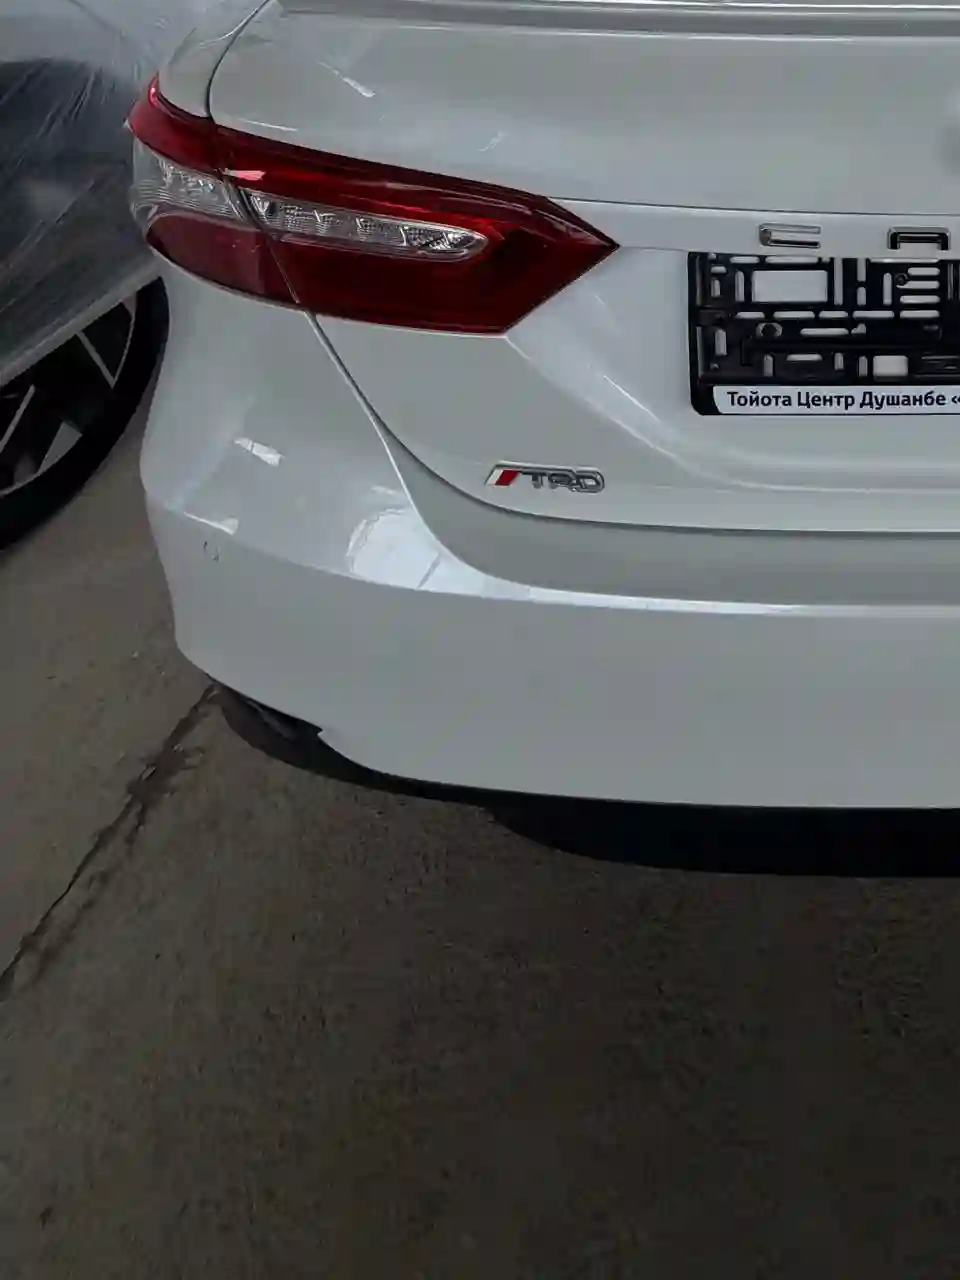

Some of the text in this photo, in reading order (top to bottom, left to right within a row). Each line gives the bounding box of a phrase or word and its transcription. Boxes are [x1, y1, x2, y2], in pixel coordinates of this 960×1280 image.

[726, 390, 792, 407] Тойота
[796, 390, 855, 411] Центр
[859, 389, 947, 411] Душанбе
[517, 464, 605, 494] TRD
